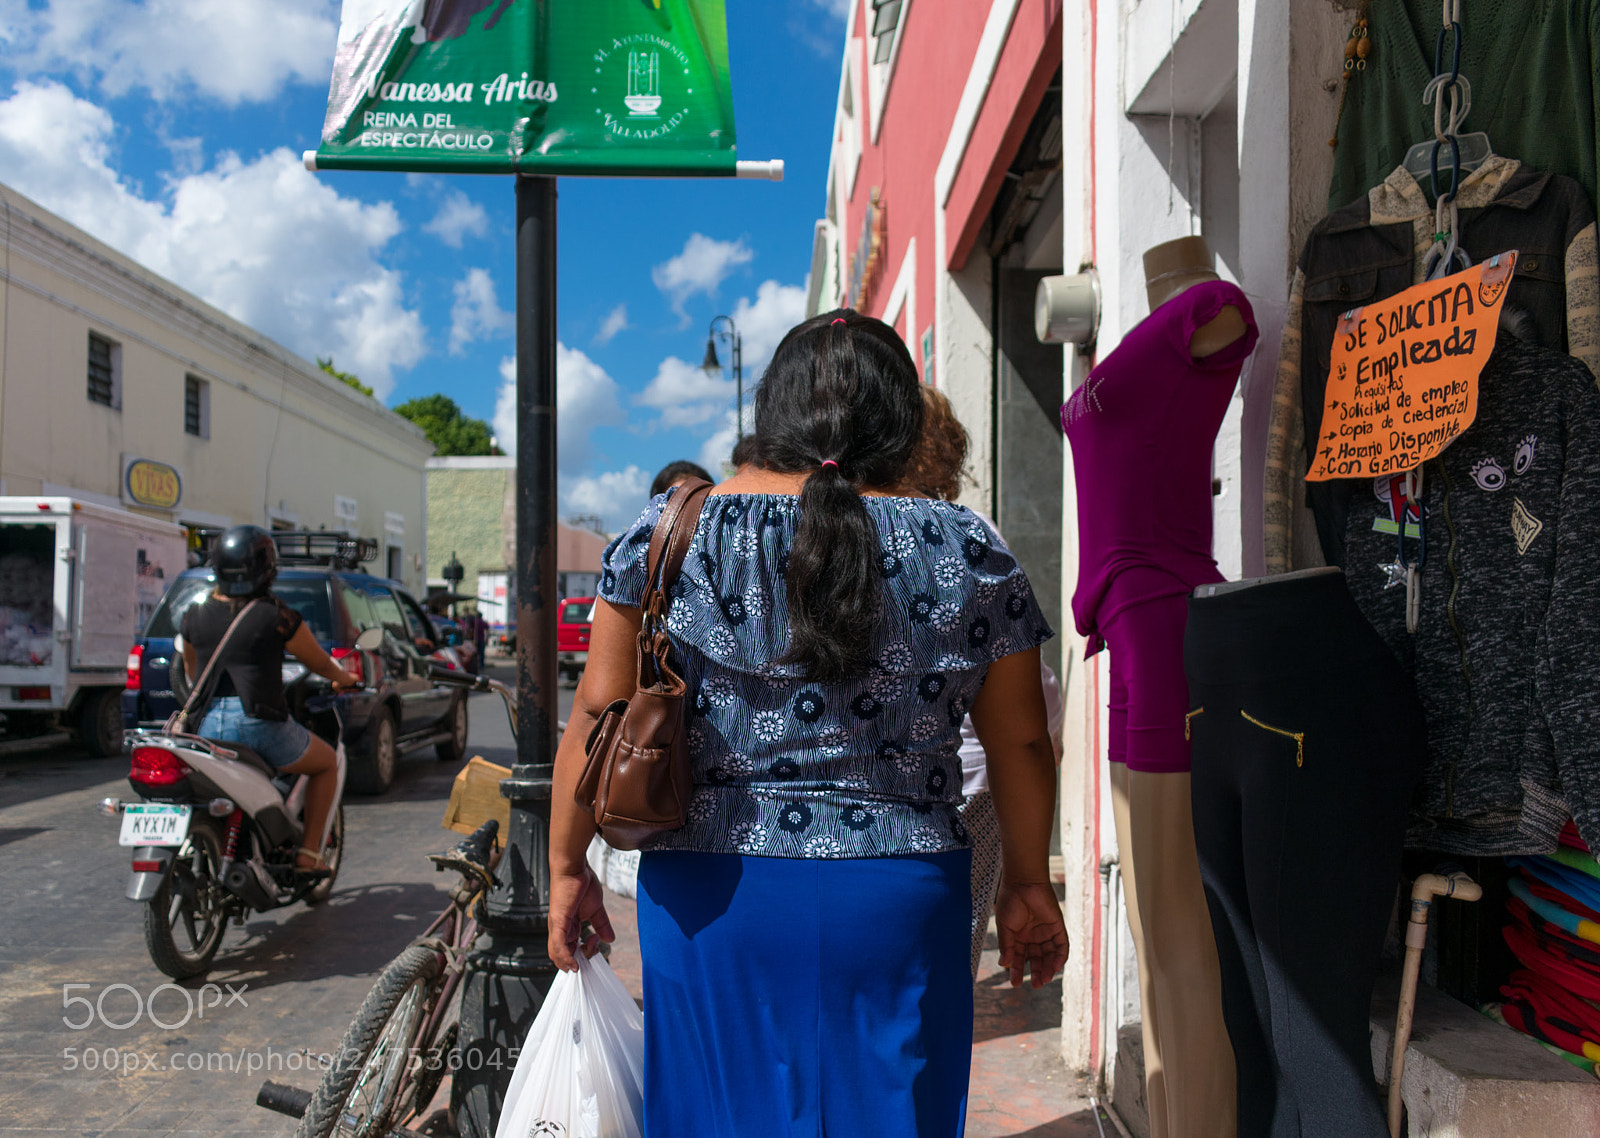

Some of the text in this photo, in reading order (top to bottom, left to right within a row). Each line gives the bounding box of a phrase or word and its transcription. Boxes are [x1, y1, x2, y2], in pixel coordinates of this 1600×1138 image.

[613, 34, 688, 63] AYUNTAMIENTO
[366, 71, 558, 105] Vanessa Arias
[363, 111, 456, 129] REINA DEL
[605, 113, 683, 139] VALLADOLID
[361, 131, 493, 150] ESPECTÁCULO
[1376, 282, 1474, 345] SOLICITA
[1357, 326, 1478, 385] Empleada
[1340, 380, 1469, 421] Solicitud de empleo
[1354, 375, 1403, 400] Requisitos
[1340, 421, 1373, 441] Copia
[1381, 414, 1394, 429] de
[1328, 457, 1362, 475] Con
[1369, 451, 1420, 475] Ganas
[1338, 441, 1383, 459] Horario
